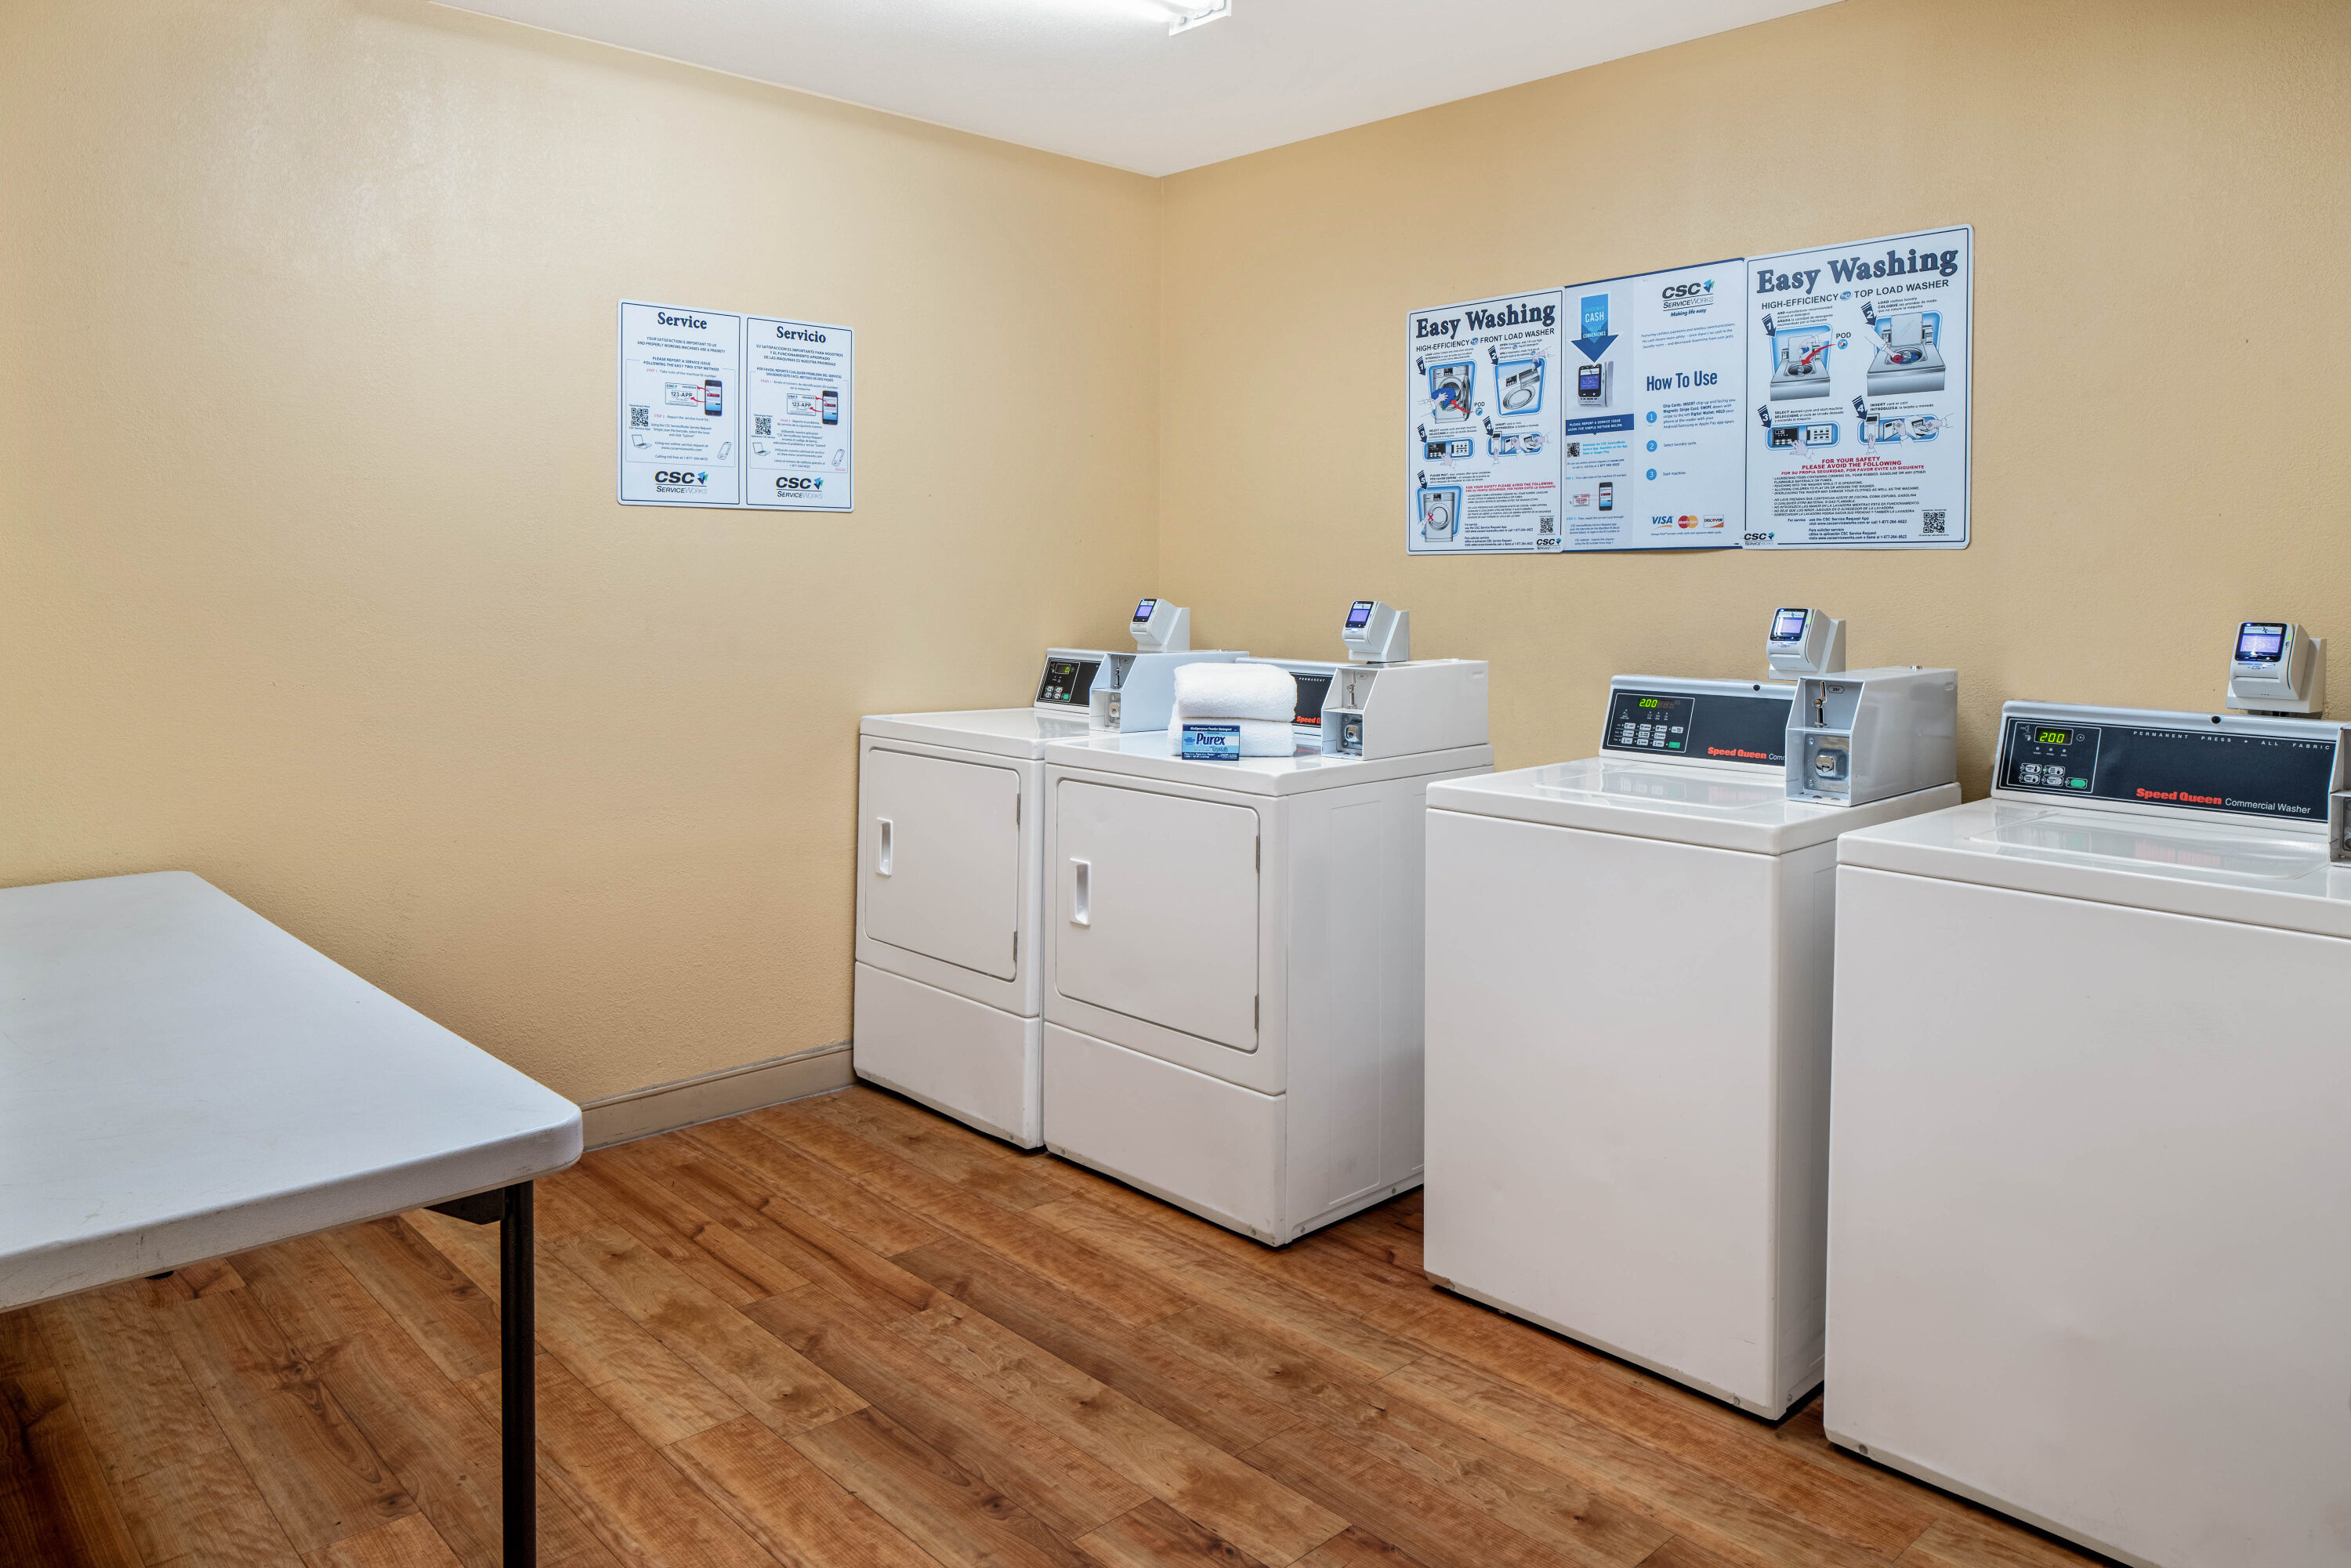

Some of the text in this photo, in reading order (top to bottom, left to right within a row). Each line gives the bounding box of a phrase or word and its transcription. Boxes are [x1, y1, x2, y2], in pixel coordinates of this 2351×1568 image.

[1756, 248, 1959, 295] Easy Washing
[1661, 282, 1701, 299] CSC
[1761, 279, 1949, 310] HIGH-EFFICIENCY TOP LOAD WASHER
[657, 312, 708, 329] Service
[1415, 302, 1556, 340] Easy Washing
[1585, 311, 1604, 323] CASH
[1866, 310, 1874, 319] 2
[777, 326, 826, 343] Servicio
[1416, 328, 1555, 353] HIGH-EFFICIENCY FRONT LOAD WASHER
[1646, 370, 1718, 392] How To Use
[1762, 413, 1769, 422] 3
[654, 470, 695, 484] CSC
[775, 476, 812, 490] CSC
[1652, 516, 1673, 524] VISA
[1639, 698, 1658, 708] 2.00
[1296, 715, 1317, 724] Speed
[1196, 733, 1226, 746] Purex
[2039, 732, 2065, 744] 200
[2133, 730, 2189, 739] PERMANENT
[1707, 747, 1737, 756] Speed
[1737, 749, 1767, 759] Queen
[2135, 788, 2311, 815] Speed Queen Commercial Washer
